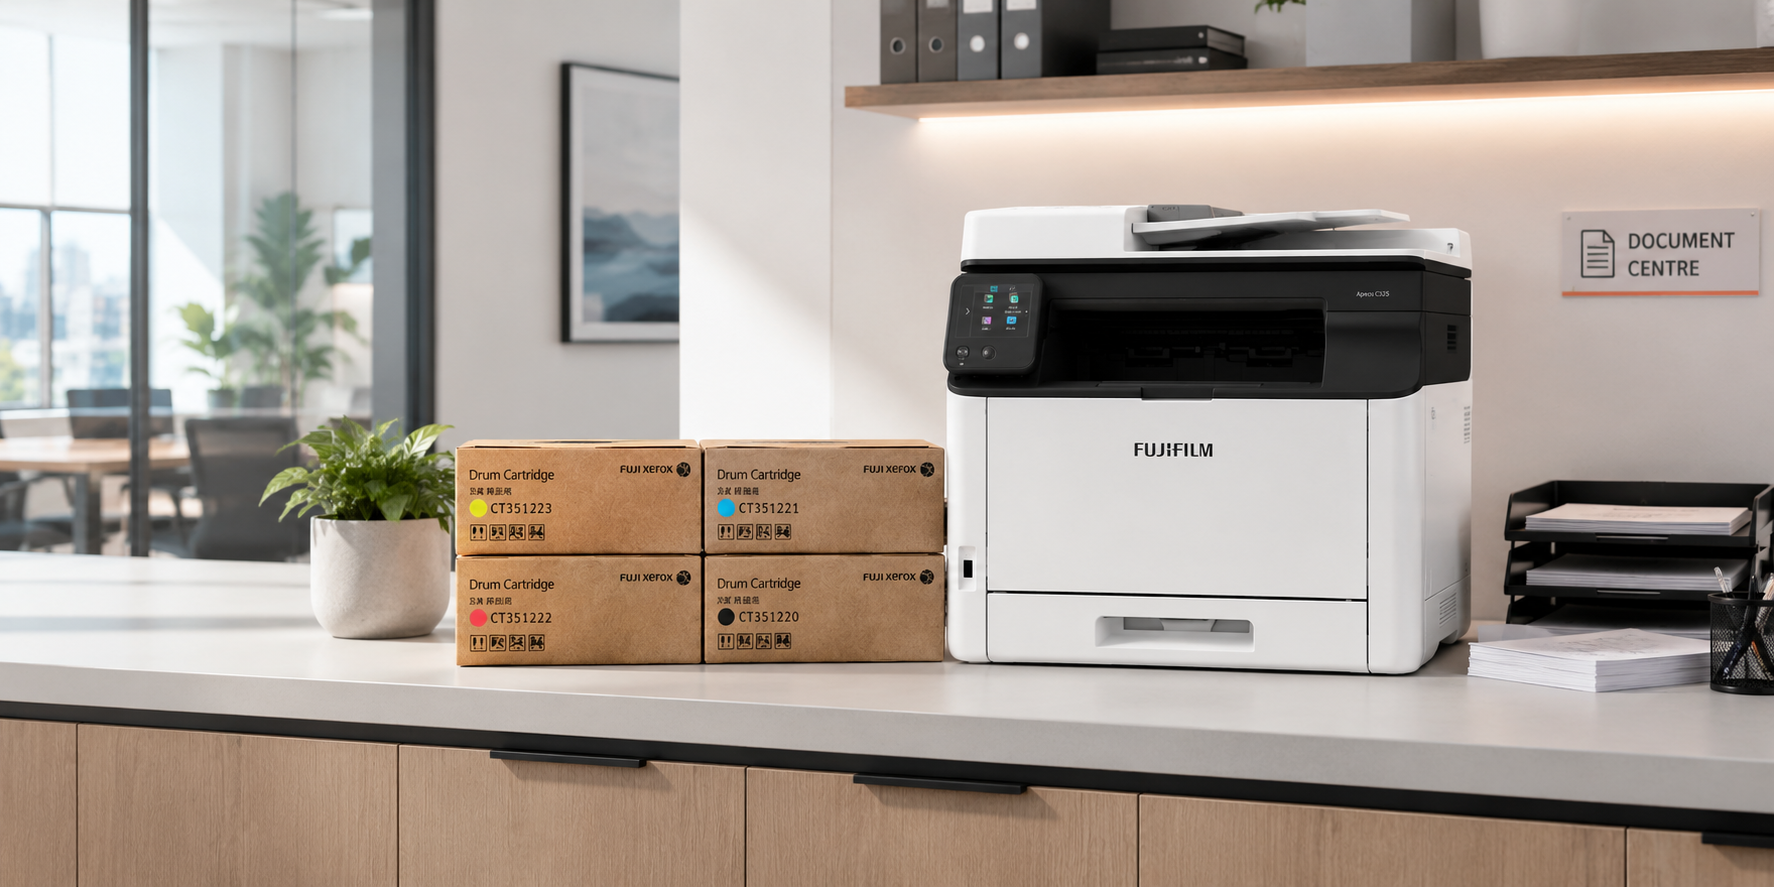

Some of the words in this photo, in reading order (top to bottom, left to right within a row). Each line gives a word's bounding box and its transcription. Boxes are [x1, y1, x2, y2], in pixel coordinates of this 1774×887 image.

[1629, 232, 1735, 249] DOCUMENT
[1628, 260, 1699, 276] CENTRE
[1134, 443, 1213, 457] FUJIFILM
[620, 465, 640, 473] FUJI
[718, 469, 747, 480] Drum
[751, 469, 801, 482] Cartridge
[470, 470, 500, 480] Drum
[504, 469, 554, 483] Cartridge
[491, 503, 551, 514] CT351223
[739, 503, 798, 513] CT351221
[864, 573, 883, 581] FUJI
[470, 579, 500, 589] Drum
[504, 579, 554, 592] Cartridge
[718, 578, 747, 588] Drum
[751, 578, 801, 591] Cartridge
[491, 612, 551, 623] CT351222
[739, 611, 799, 622] CT351220
